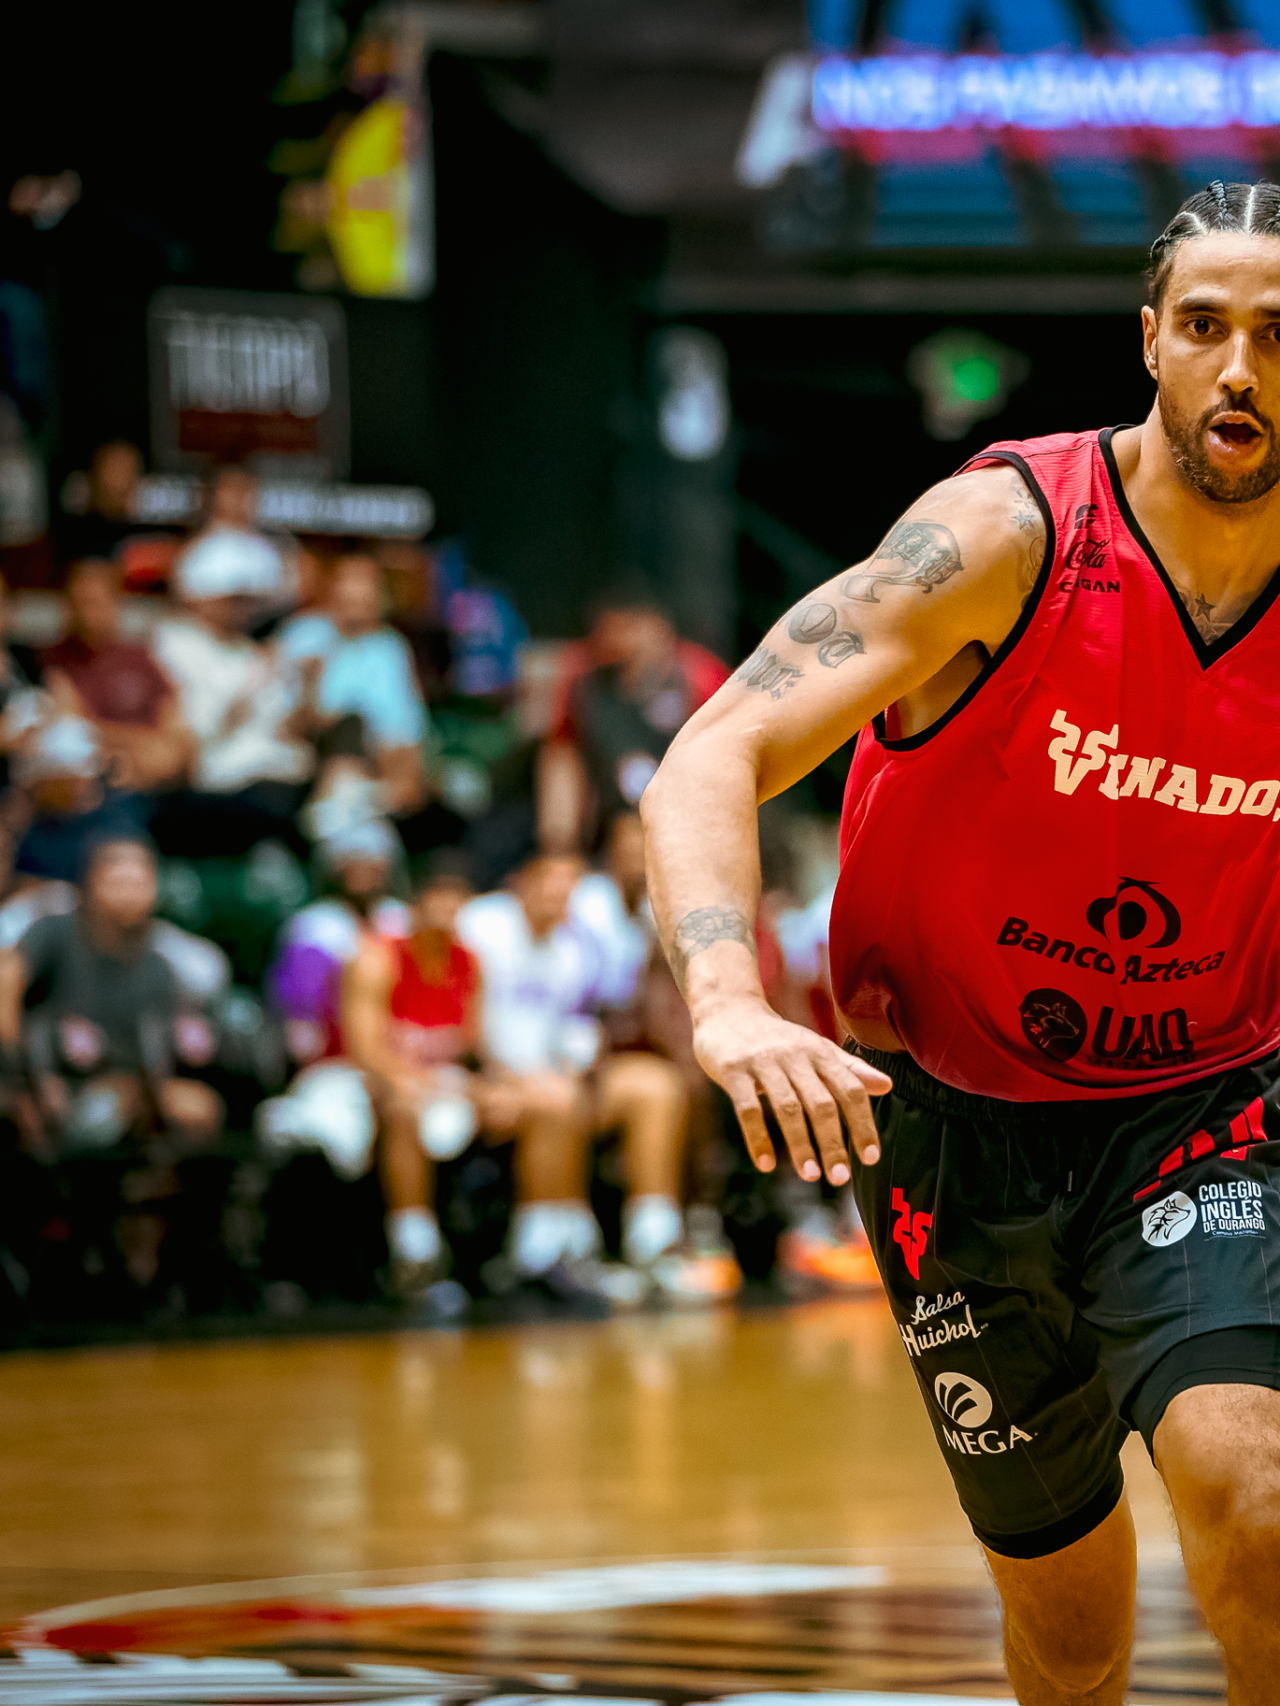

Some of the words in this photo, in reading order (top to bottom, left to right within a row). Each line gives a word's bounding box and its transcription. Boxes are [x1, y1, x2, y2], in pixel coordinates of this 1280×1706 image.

[996, 916, 1116, 975] Banco
[1119, 950, 1226, 985] Azteca
[1199, 1180, 1262, 1202] COLEGIO
[1201, 1196, 1263, 1222] INGLÉS
[1203, 1220, 1216, 1233] DE
[1219, 1218, 1265, 1230] DURANGO
[910, 1291, 966, 1325] Salsa
[899, 1304, 982, 1357] Huichol
[943, 1424, 1034, 1456] MEGA
